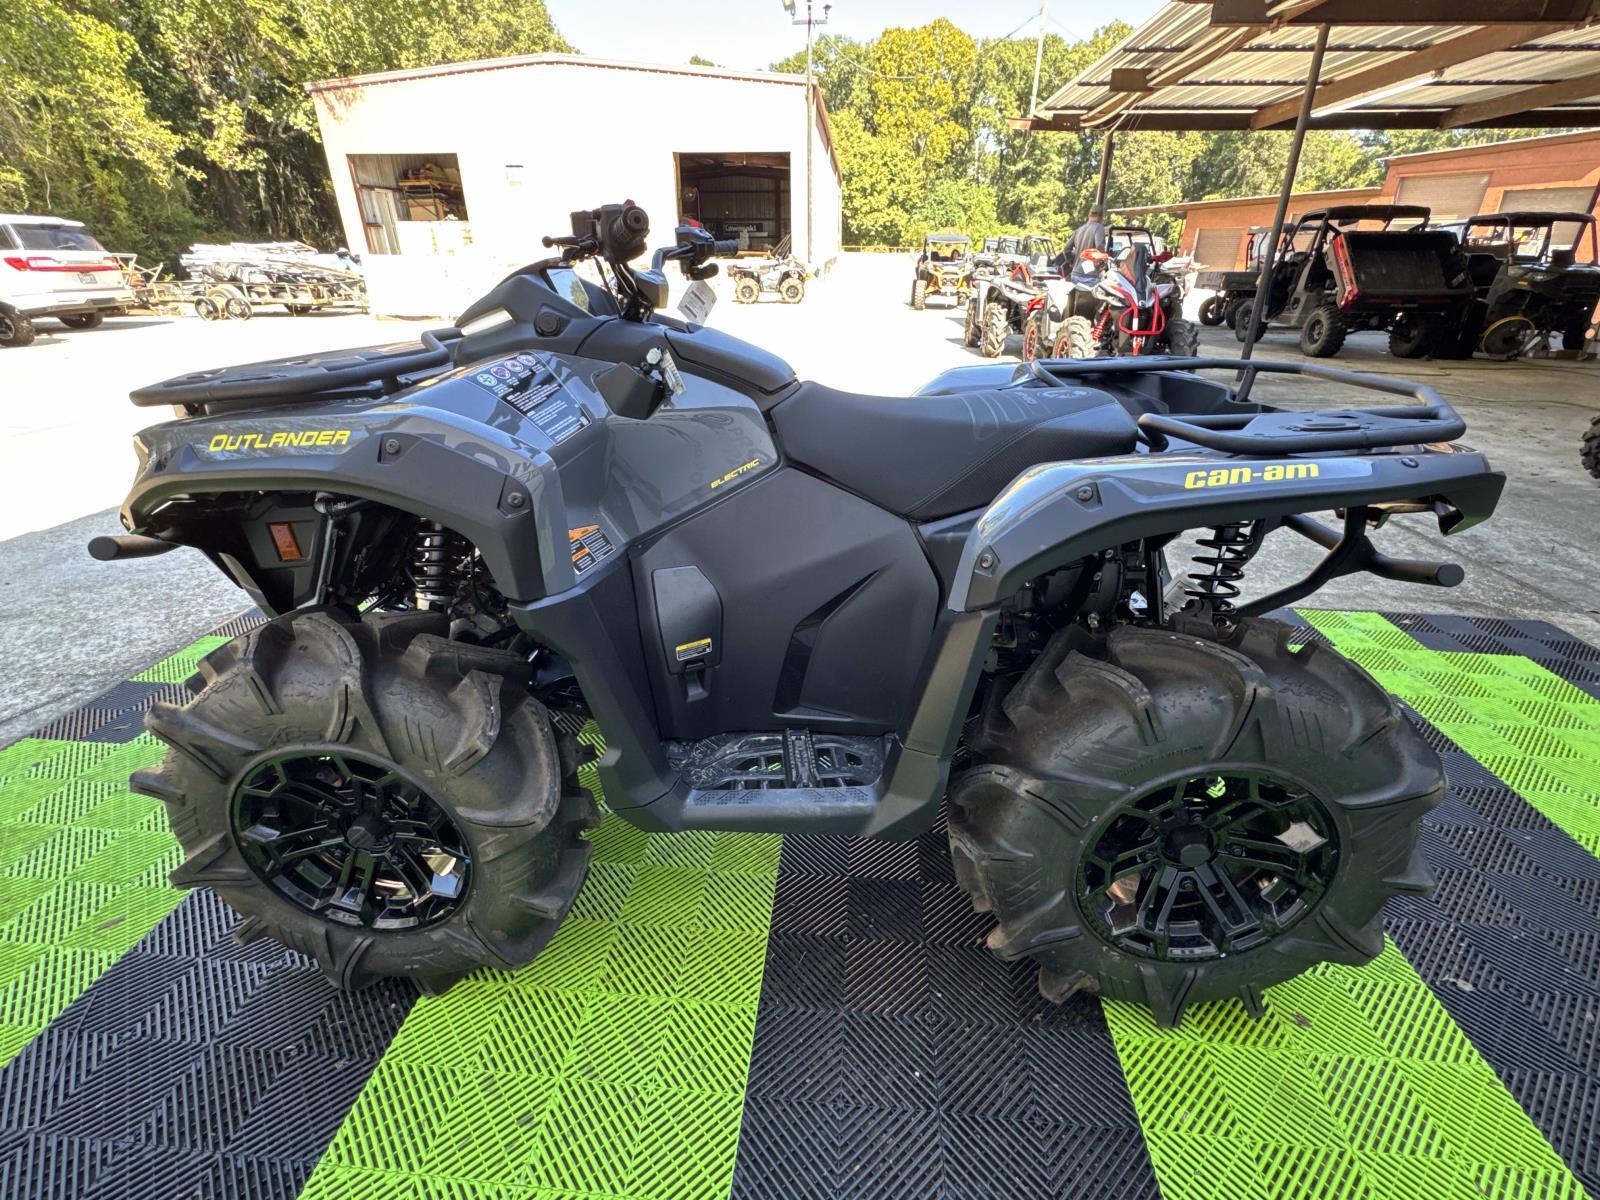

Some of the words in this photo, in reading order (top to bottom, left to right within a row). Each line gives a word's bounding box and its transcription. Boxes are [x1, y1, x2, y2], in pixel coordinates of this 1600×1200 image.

[208, 430, 351, 452] OUTLANDER
[710, 458, 760, 489] ELECTRIC
[1184, 463, 1319, 489] can-am
